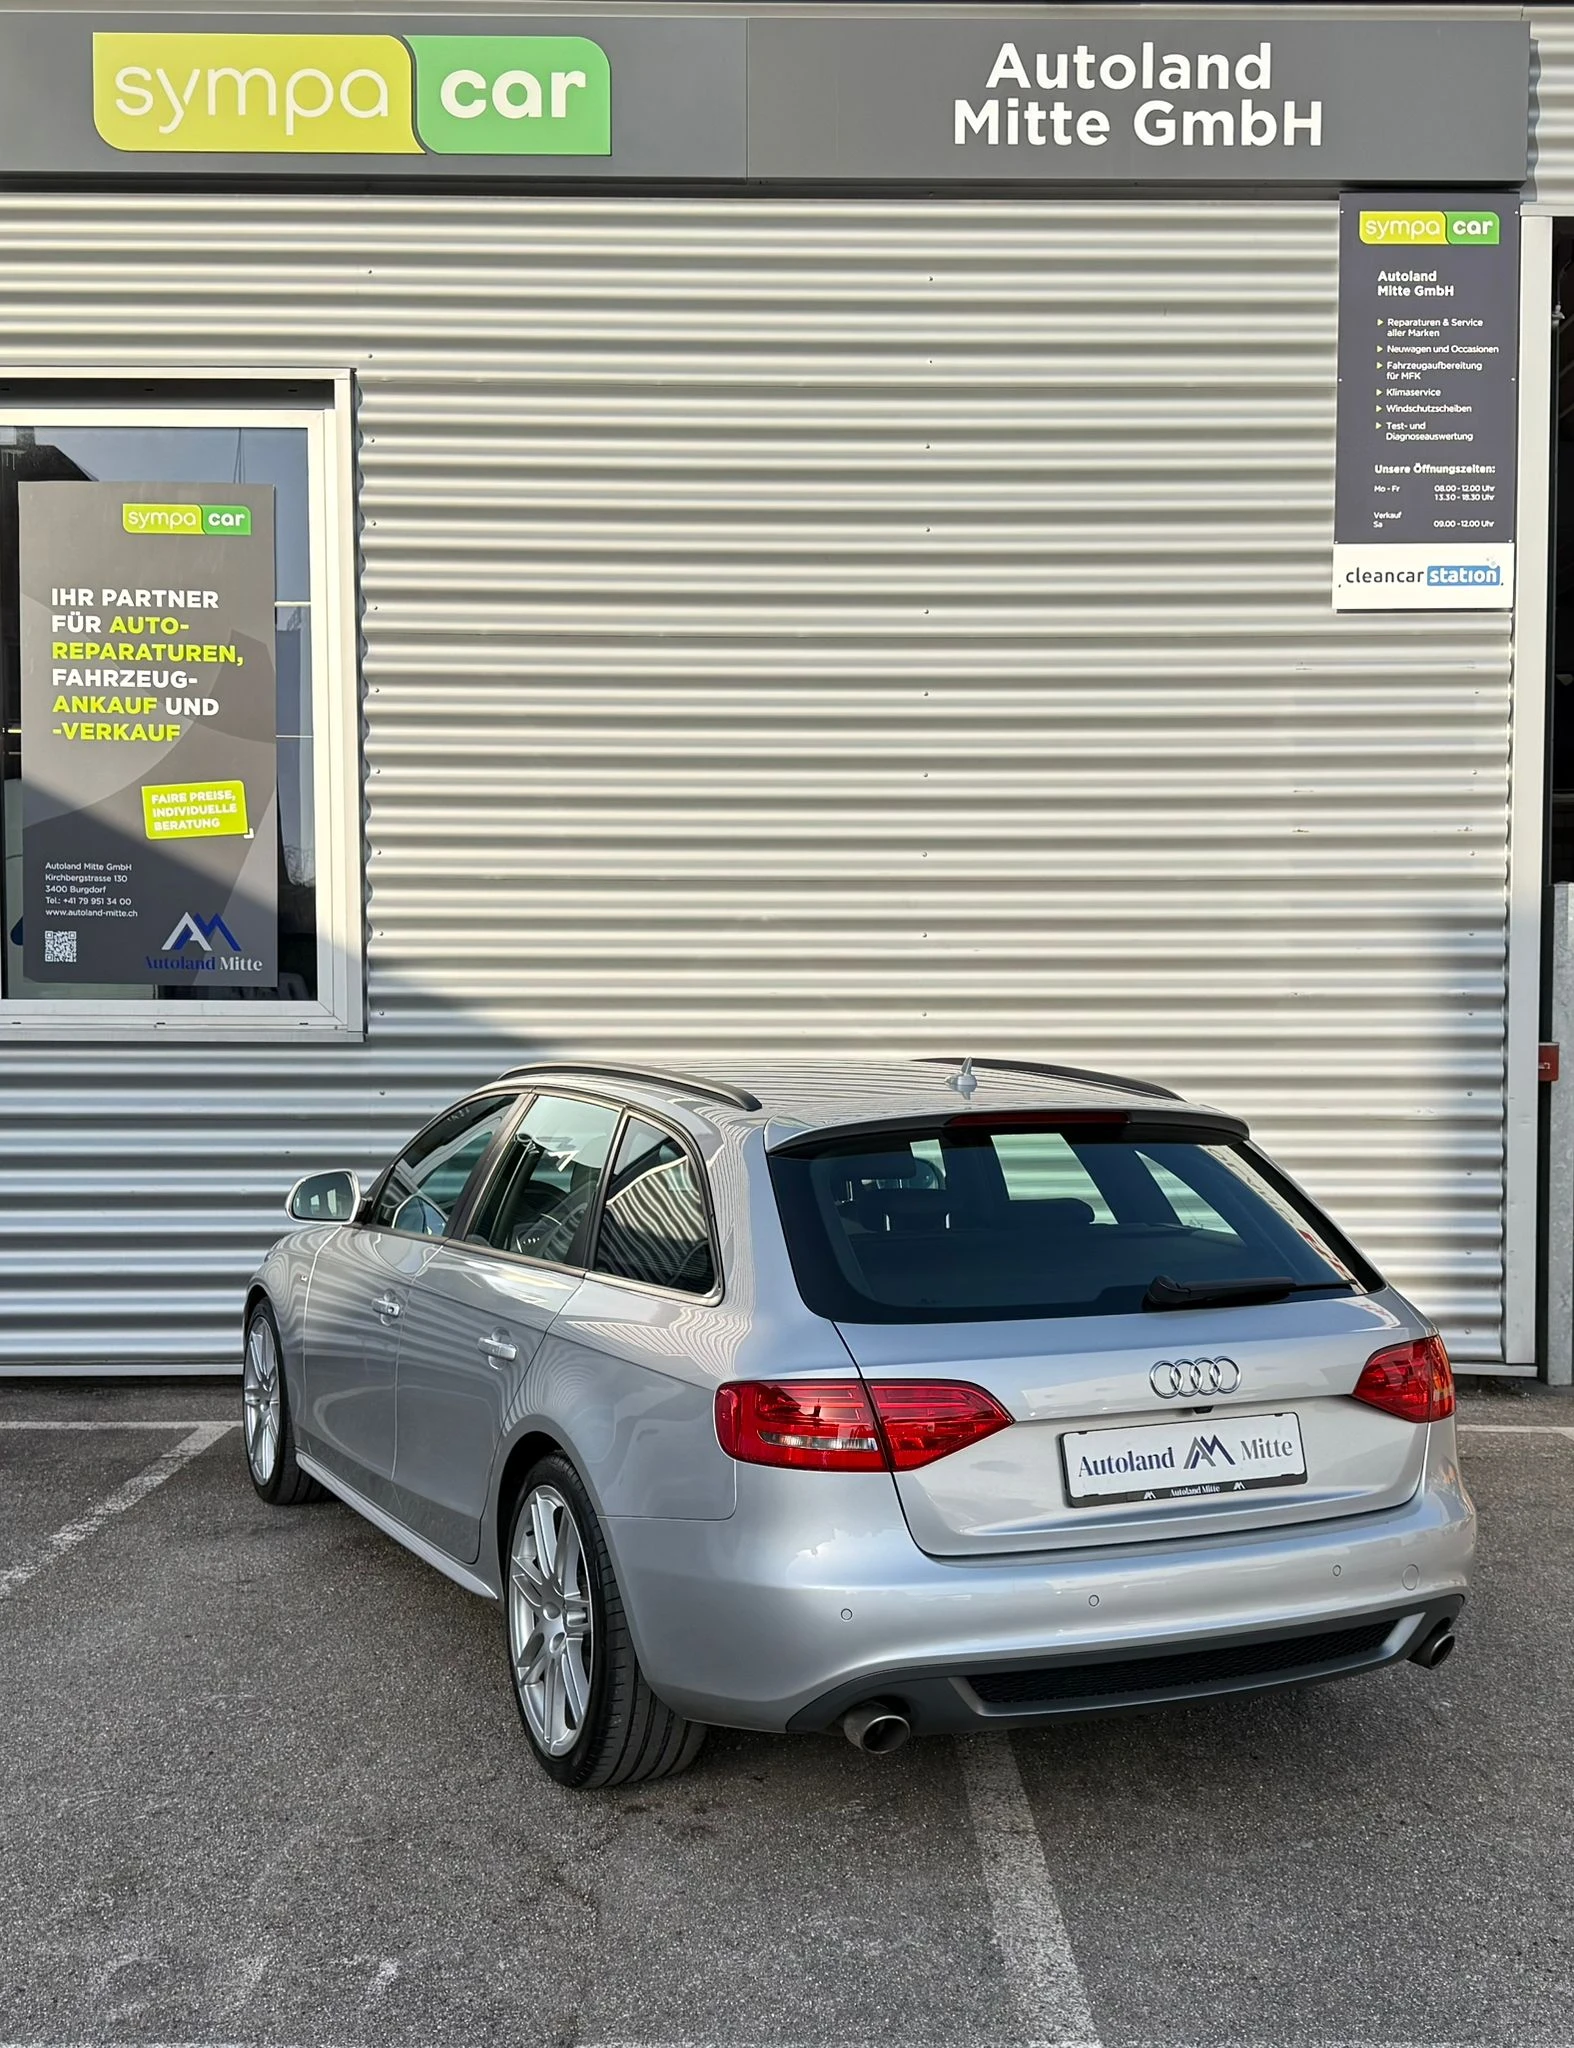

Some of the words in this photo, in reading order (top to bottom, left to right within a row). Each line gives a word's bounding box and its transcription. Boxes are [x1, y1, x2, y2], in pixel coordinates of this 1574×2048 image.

[985, 41, 1272, 91] Autoland
[114, 65, 389, 136] sympa
[440, 68, 587, 119] car
[953, 98, 1111, 147] Mitte
[1133, 99, 1323, 147] GmbH
[1365, 219, 1441, 240] sympa
[1452, 219, 1494, 235] car
[1377, 270, 1437, 282] Autoland
[1377, 285, 1411, 297] Mitte
[1414, 285, 1455, 297] GmbH
[1387, 318, 1441, 328] Reparaturen
[1442, 318, 1450, 327] &
[1451, 318, 1484, 327] Service
[1387, 329, 1406, 337] aller
[1407, 329, 1440, 337] Marken
[1386, 345, 1432, 355] Neuwagen
[1433, 345, 1450, 353] und
[1450, 345, 1500, 353] Occasionen
[1386, 361, 1483, 371] Fahrzeugaufbereitung
[1386, 372, 1400, 381] für
[1401, 372, 1422, 380] MFK
[1386, 388, 1442, 397] Klimaservice
[1386, 404, 1473, 413] Windschutzscheiben
[1385, 421, 1408, 430] Test-
[1409, 421, 1426, 430] und
[1385, 432, 1474, 442] Diagnoseauswertung
[1374, 464, 1411, 474] Unsere
[1413, 462, 1496, 475] Öffnungszeiten:
[1434, 484, 1457, 492] 08.00
[1461, 484, 1481, 492] 12.00
[1481, 484, 1496, 492] Uhr
[1434, 493, 1457, 501] 13.30
[1461, 493, 1481, 501] 18.30
[1481, 493, 1496, 501] Uhr
[128, 510, 197, 530] sympa
[208, 512, 246, 527] car
[1373, 511, 1402, 519] Verkauf
[1373, 521, 1383, 529] Sa
[1433, 520, 1457, 528] 09.00
[1460, 520, 1481, 528] 12.00
[1481, 520, 1495, 528] Uhr
[1346, 567, 1424, 583] cleancar
[1429, 567, 1498, 584] station
[51, 588, 94, 607] IHR
[102, 588, 220, 608] PARTNER
[51, 611, 101, 633] FÜR
[109, 616, 190, 635] AUTO-
[52, 642, 244, 666] REPARATUREN,
[52, 669, 198, 688] FAHRZEUG-
[52, 696, 158, 714] ANKAUF
[165, 698, 220, 716] UND
[53, 723, 181, 742] -VERKAUF
[151, 792, 187, 805] FAIRE
[190, 789, 236, 802] PREISE,
[152, 803, 238, 818] INDIVIDUELLE
[154, 817, 221, 832] BERATUNG
[45, 862, 82, 870] Autoland
[84, 863, 104, 871] Mitte
[106, 863, 132, 871] GmbH
[45, 874, 112, 883] Kirchbergstrasse
[113, 875, 128, 883] 130
[45, 885, 68, 893] 3400
[70, 886, 107, 894] Burgdorf
[45, 896, 61, 904] Tel.:
[63, 897, 76, 905] +41
[79, 897, 88, 905] 79
[119, 898, 132, 906] 00
[45, 909, 138, 918] www.autoland-mitte.ch
[220, 956, 263, 971] Mitte
[1078, 1447, 1175, 1478] Autoland
[1240, 1439, 1293, 1461] Mitte
[1170, 1486, 1201, 1497] Autoland
[1201, 1484, 1220, 1494] Mitte
